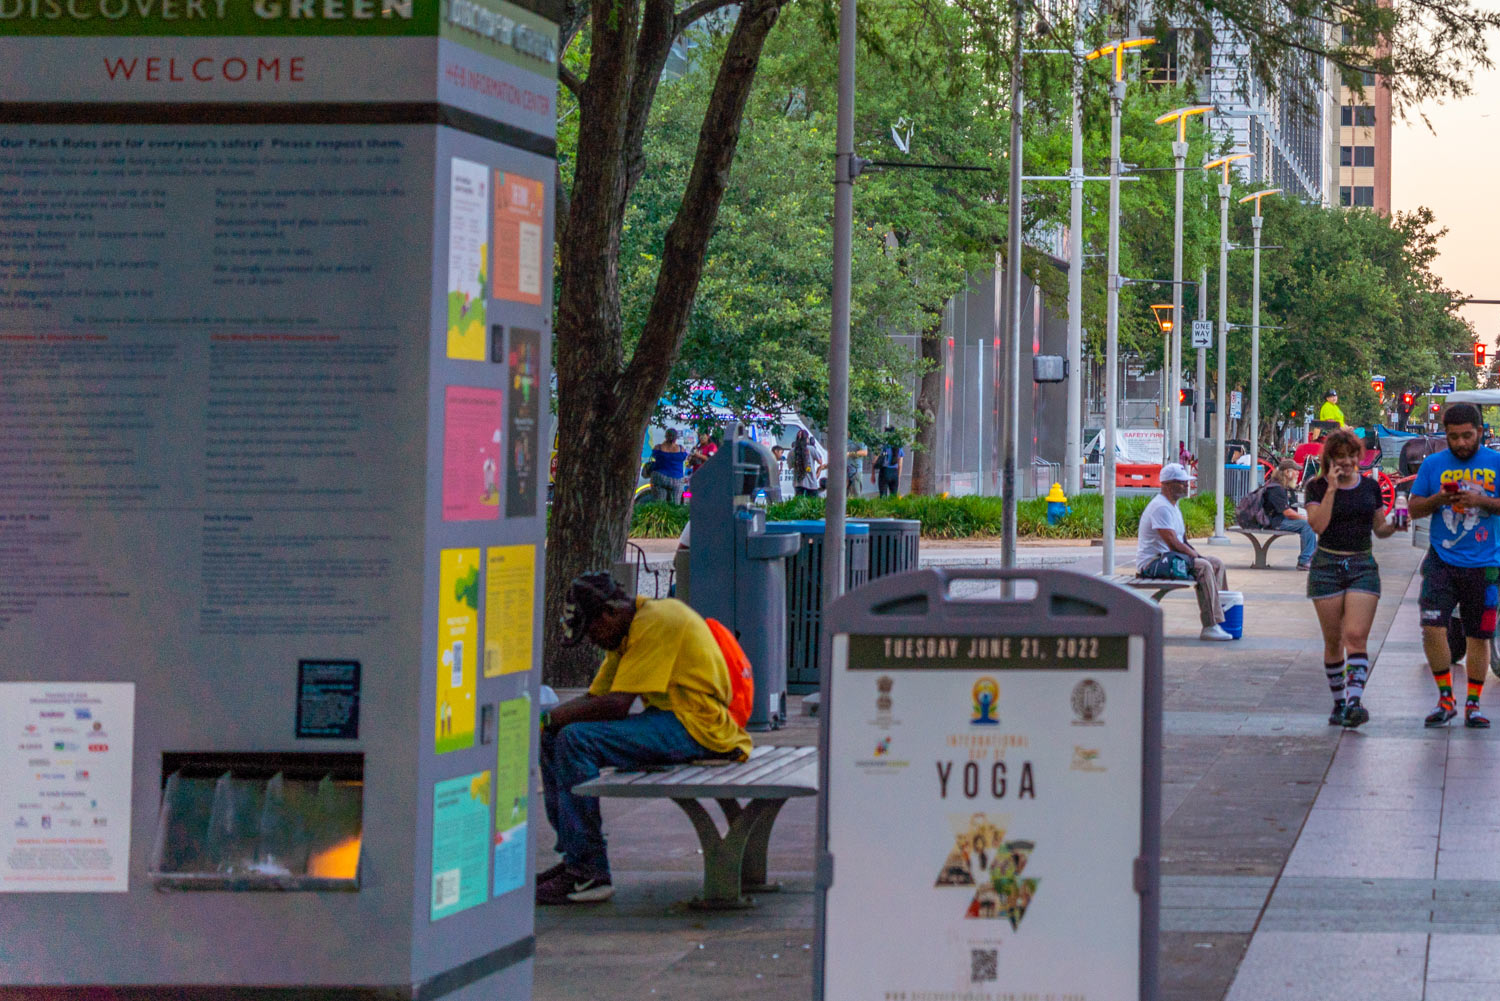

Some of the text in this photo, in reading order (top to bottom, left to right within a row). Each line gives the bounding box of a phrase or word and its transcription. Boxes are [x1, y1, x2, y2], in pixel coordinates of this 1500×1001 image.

[104, 57, 306, 82] WELCOME
[1440, 468, 1496, 492] SPACE
[884, 638, 1100, 658] TUESDAY JUNE 21, 2022
[946, 734, 1029, 748] INTERNATIONAL
[936, 760, 1036, 799] YOGA
